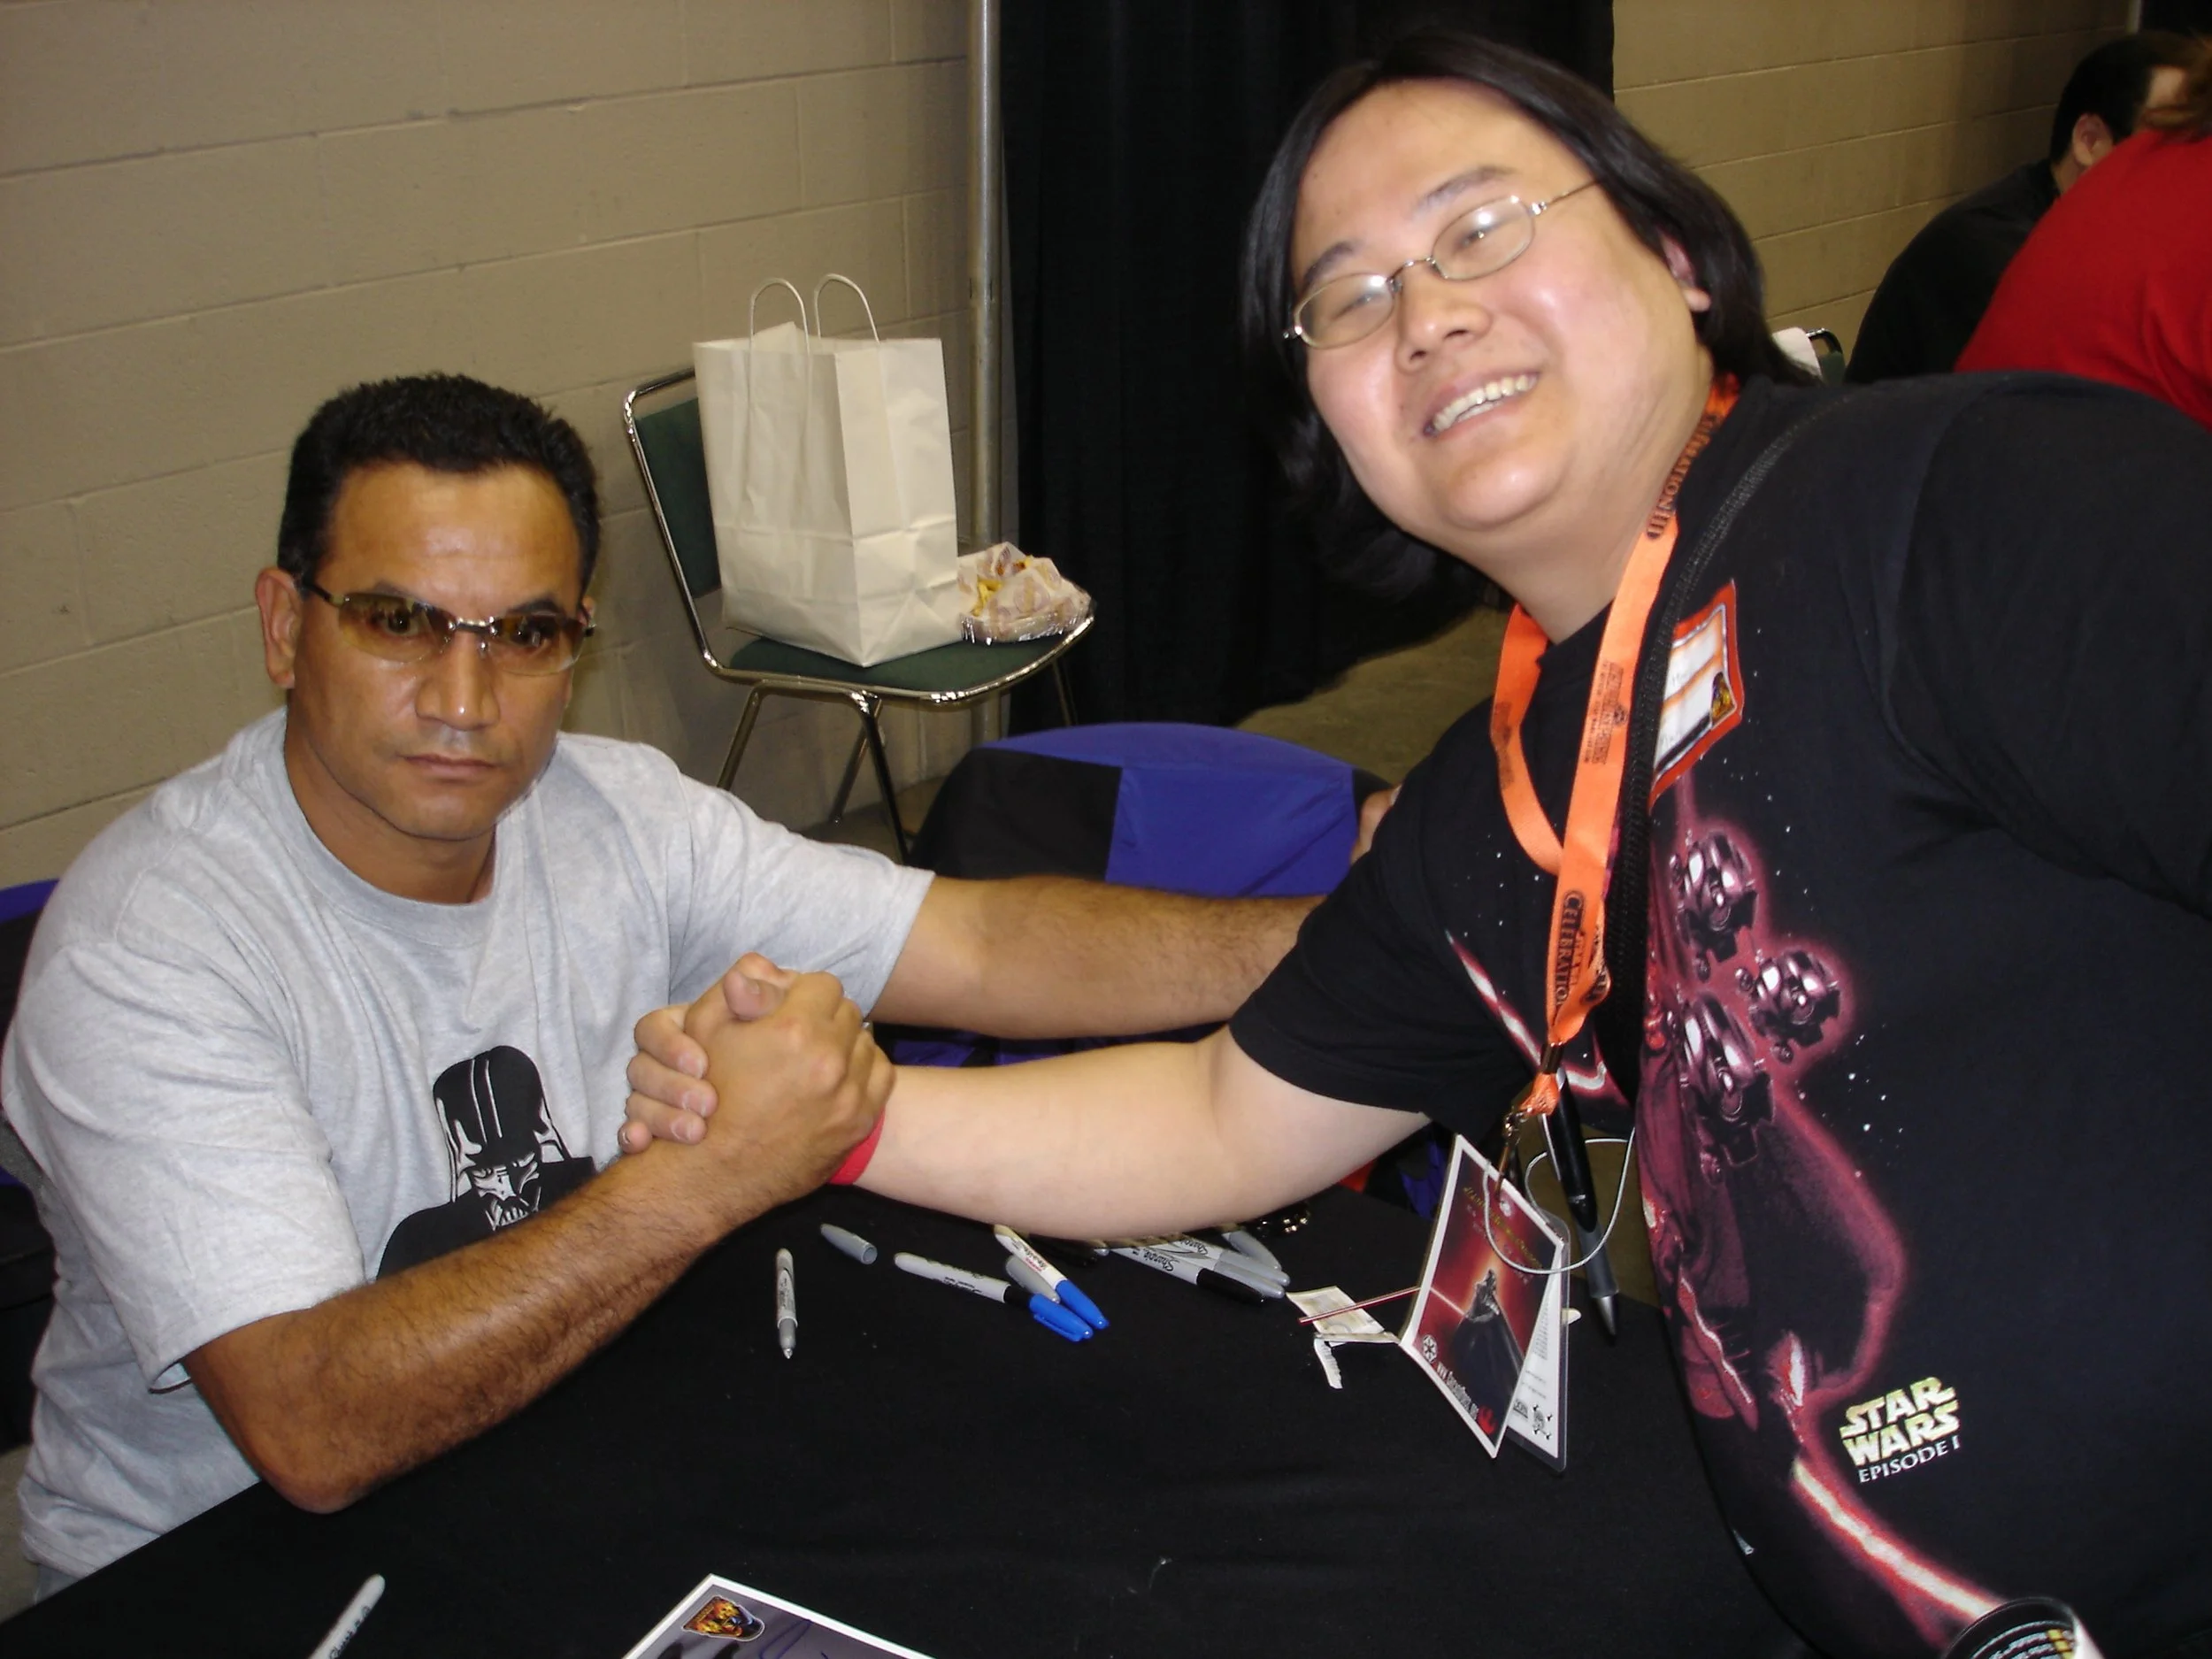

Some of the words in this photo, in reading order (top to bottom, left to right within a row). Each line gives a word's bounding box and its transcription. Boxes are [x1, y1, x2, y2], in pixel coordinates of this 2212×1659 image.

[1144, 1248, 1179, 1272] Sharpie
[1839, 1376, 1956, 1439] STAR
[1842, 1399, 1961, 1466] WARS
[1858, 1440, 1949, 1484] EPISODE
[1951, 1435, 1961, 1450] I
